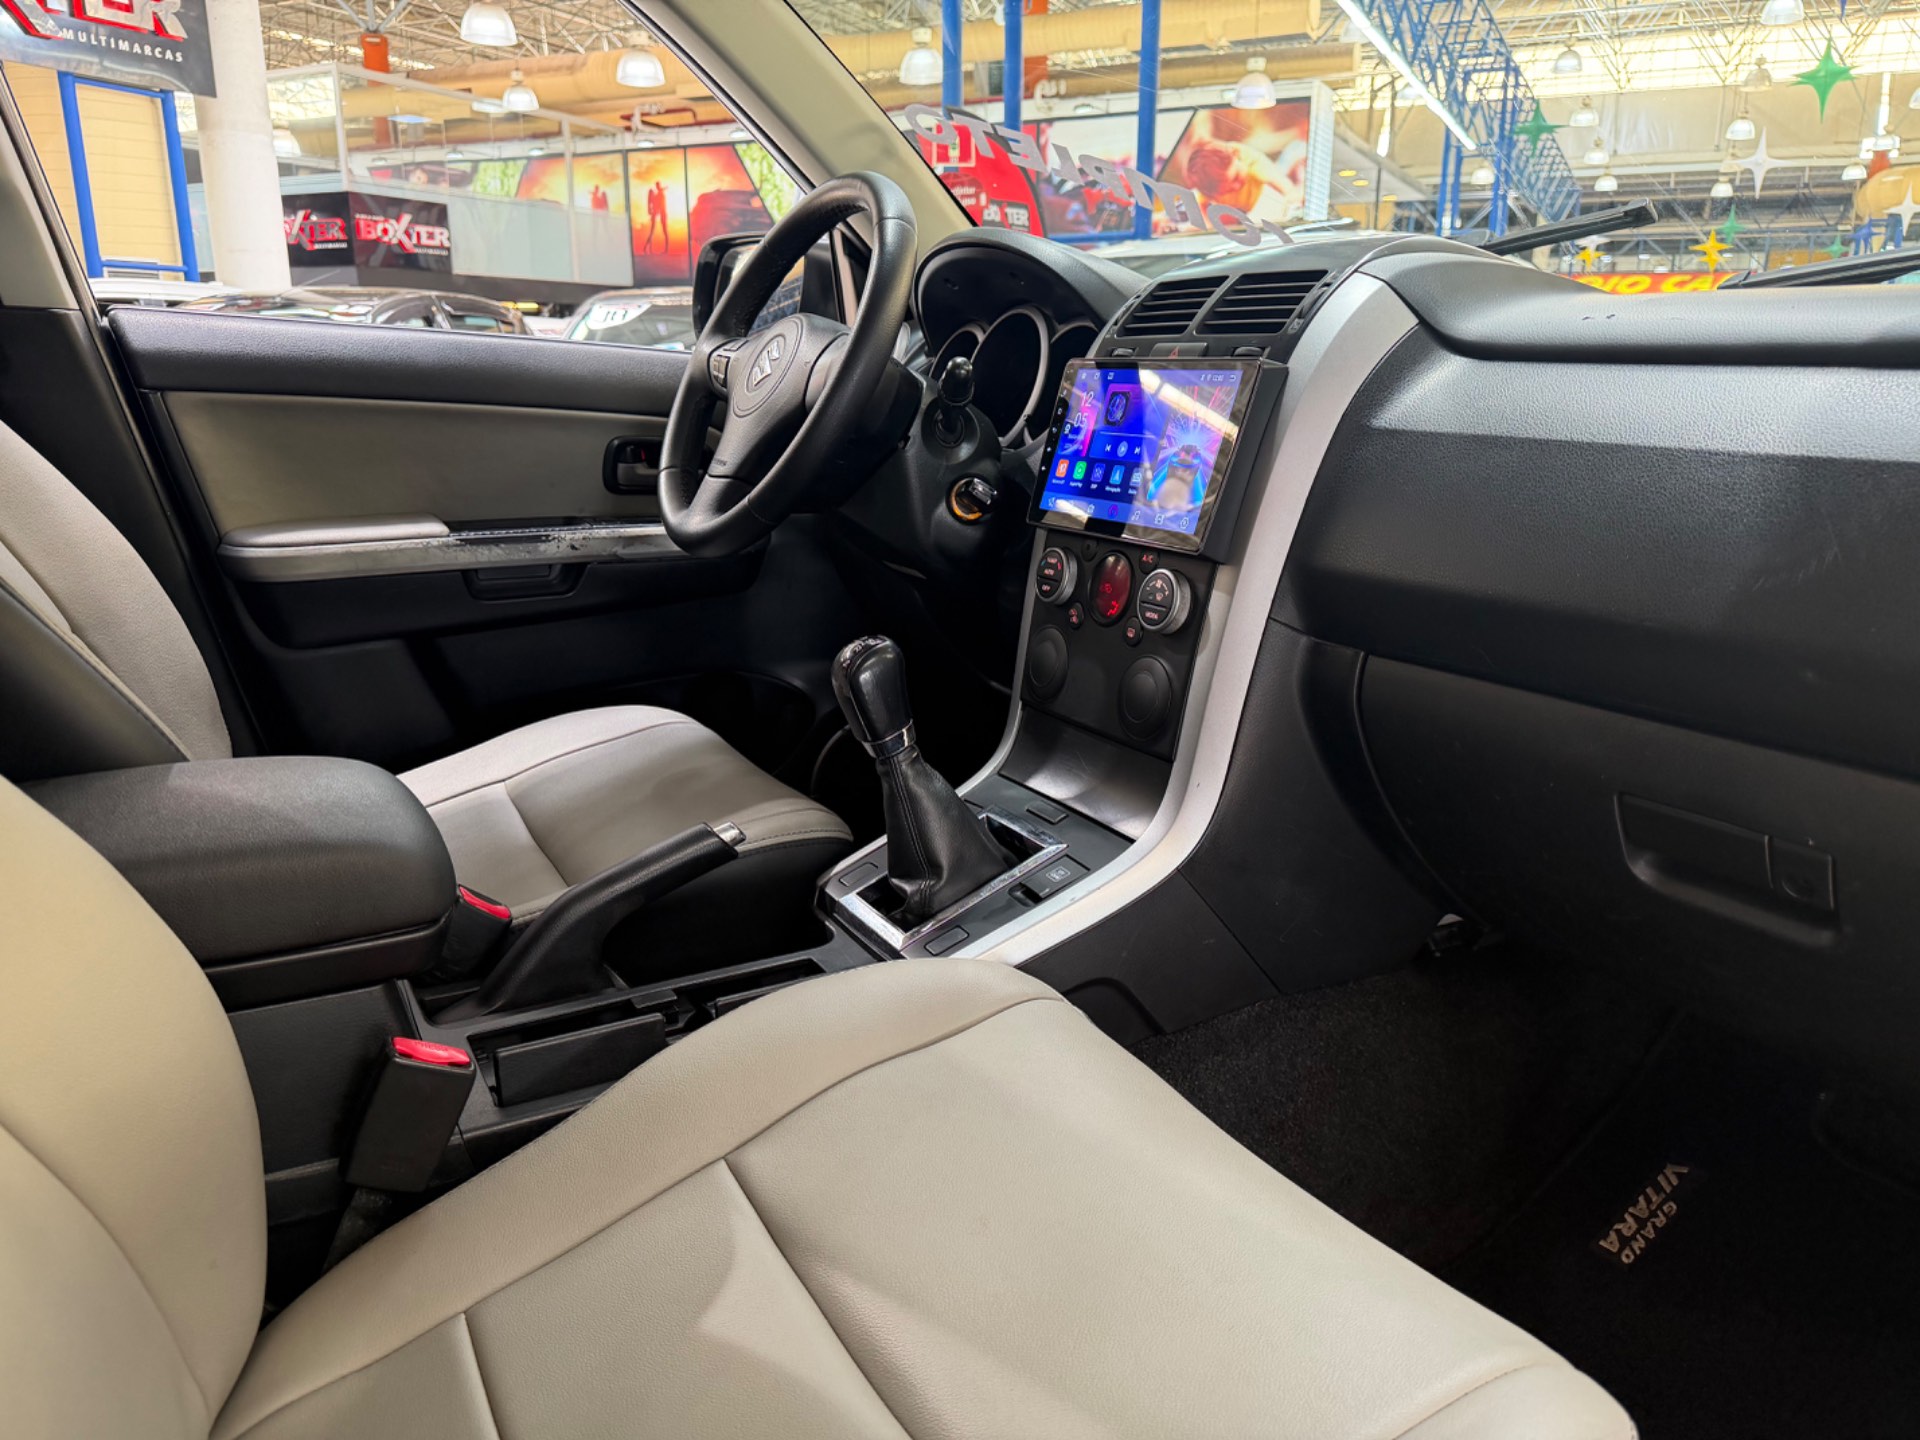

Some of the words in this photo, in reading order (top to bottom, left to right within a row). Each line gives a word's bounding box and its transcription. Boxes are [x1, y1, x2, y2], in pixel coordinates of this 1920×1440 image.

[61, 28, 184, 62] MULTIMARCAS
[355, 213, 450, 253] BOXTER
[1599, 1163, 1689, 1253] VITARA
[1620, 1201, 1677, 1264] GRAND
